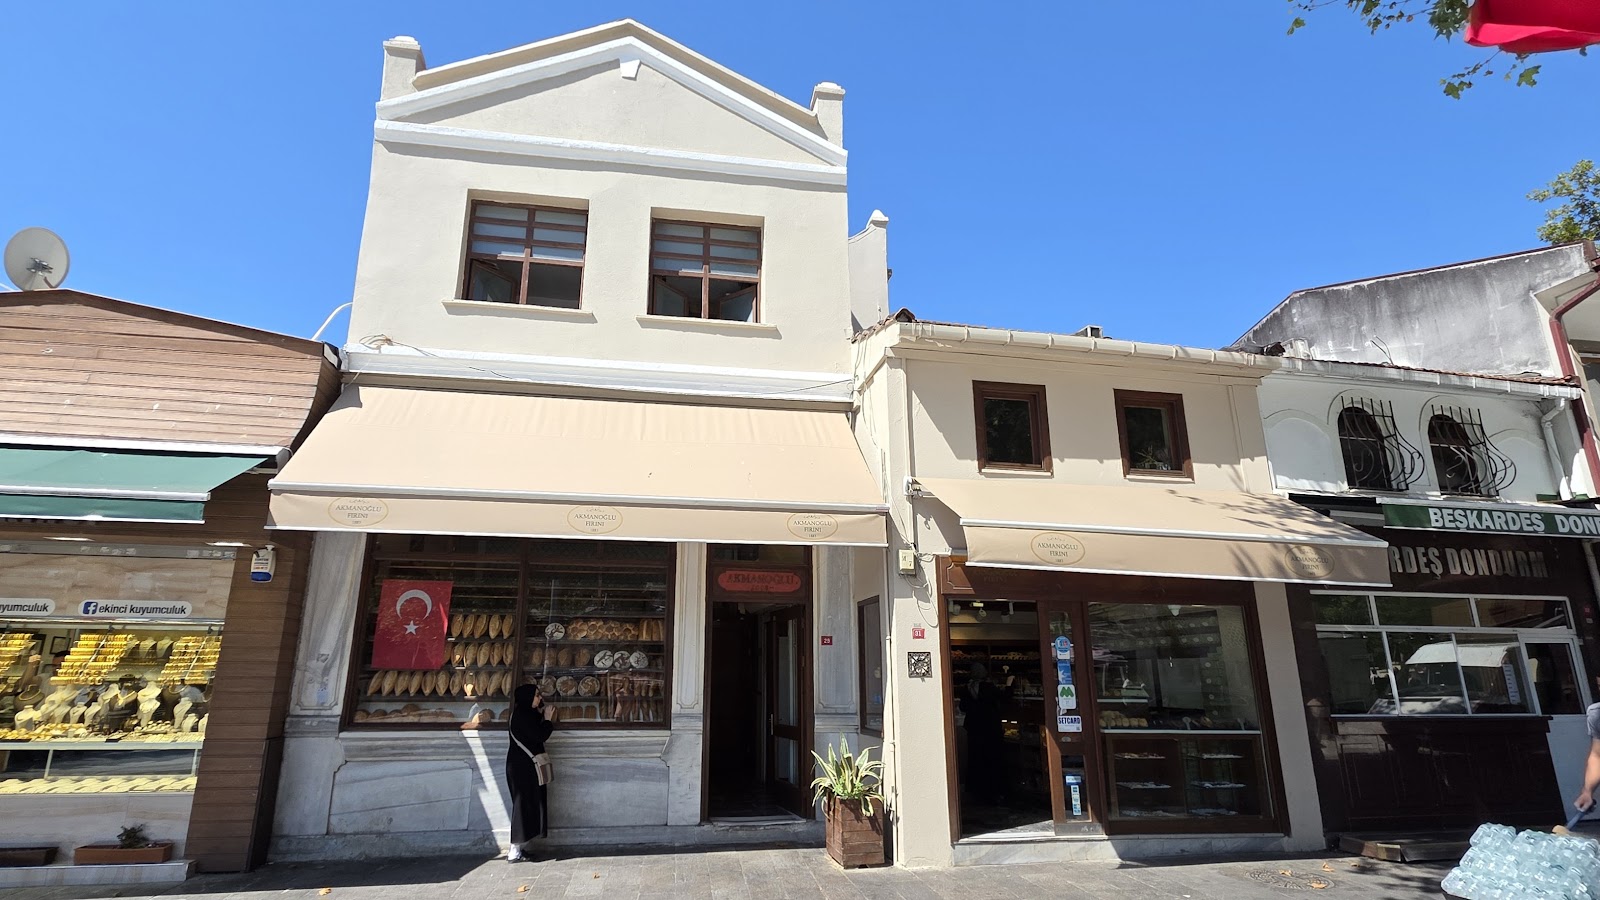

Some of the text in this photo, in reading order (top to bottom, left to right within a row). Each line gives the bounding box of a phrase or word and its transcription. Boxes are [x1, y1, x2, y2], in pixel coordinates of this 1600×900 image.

[335, 504, 382, 513] AKMANOĞLU
[1429, 507, 1546, 534] BEŞKARDEŞ
[1387, 545, 1443, 580] RDEŞ
[98, 604, 128, 614] ekinci
[130, 605, 186, 615] kuyumculuk
